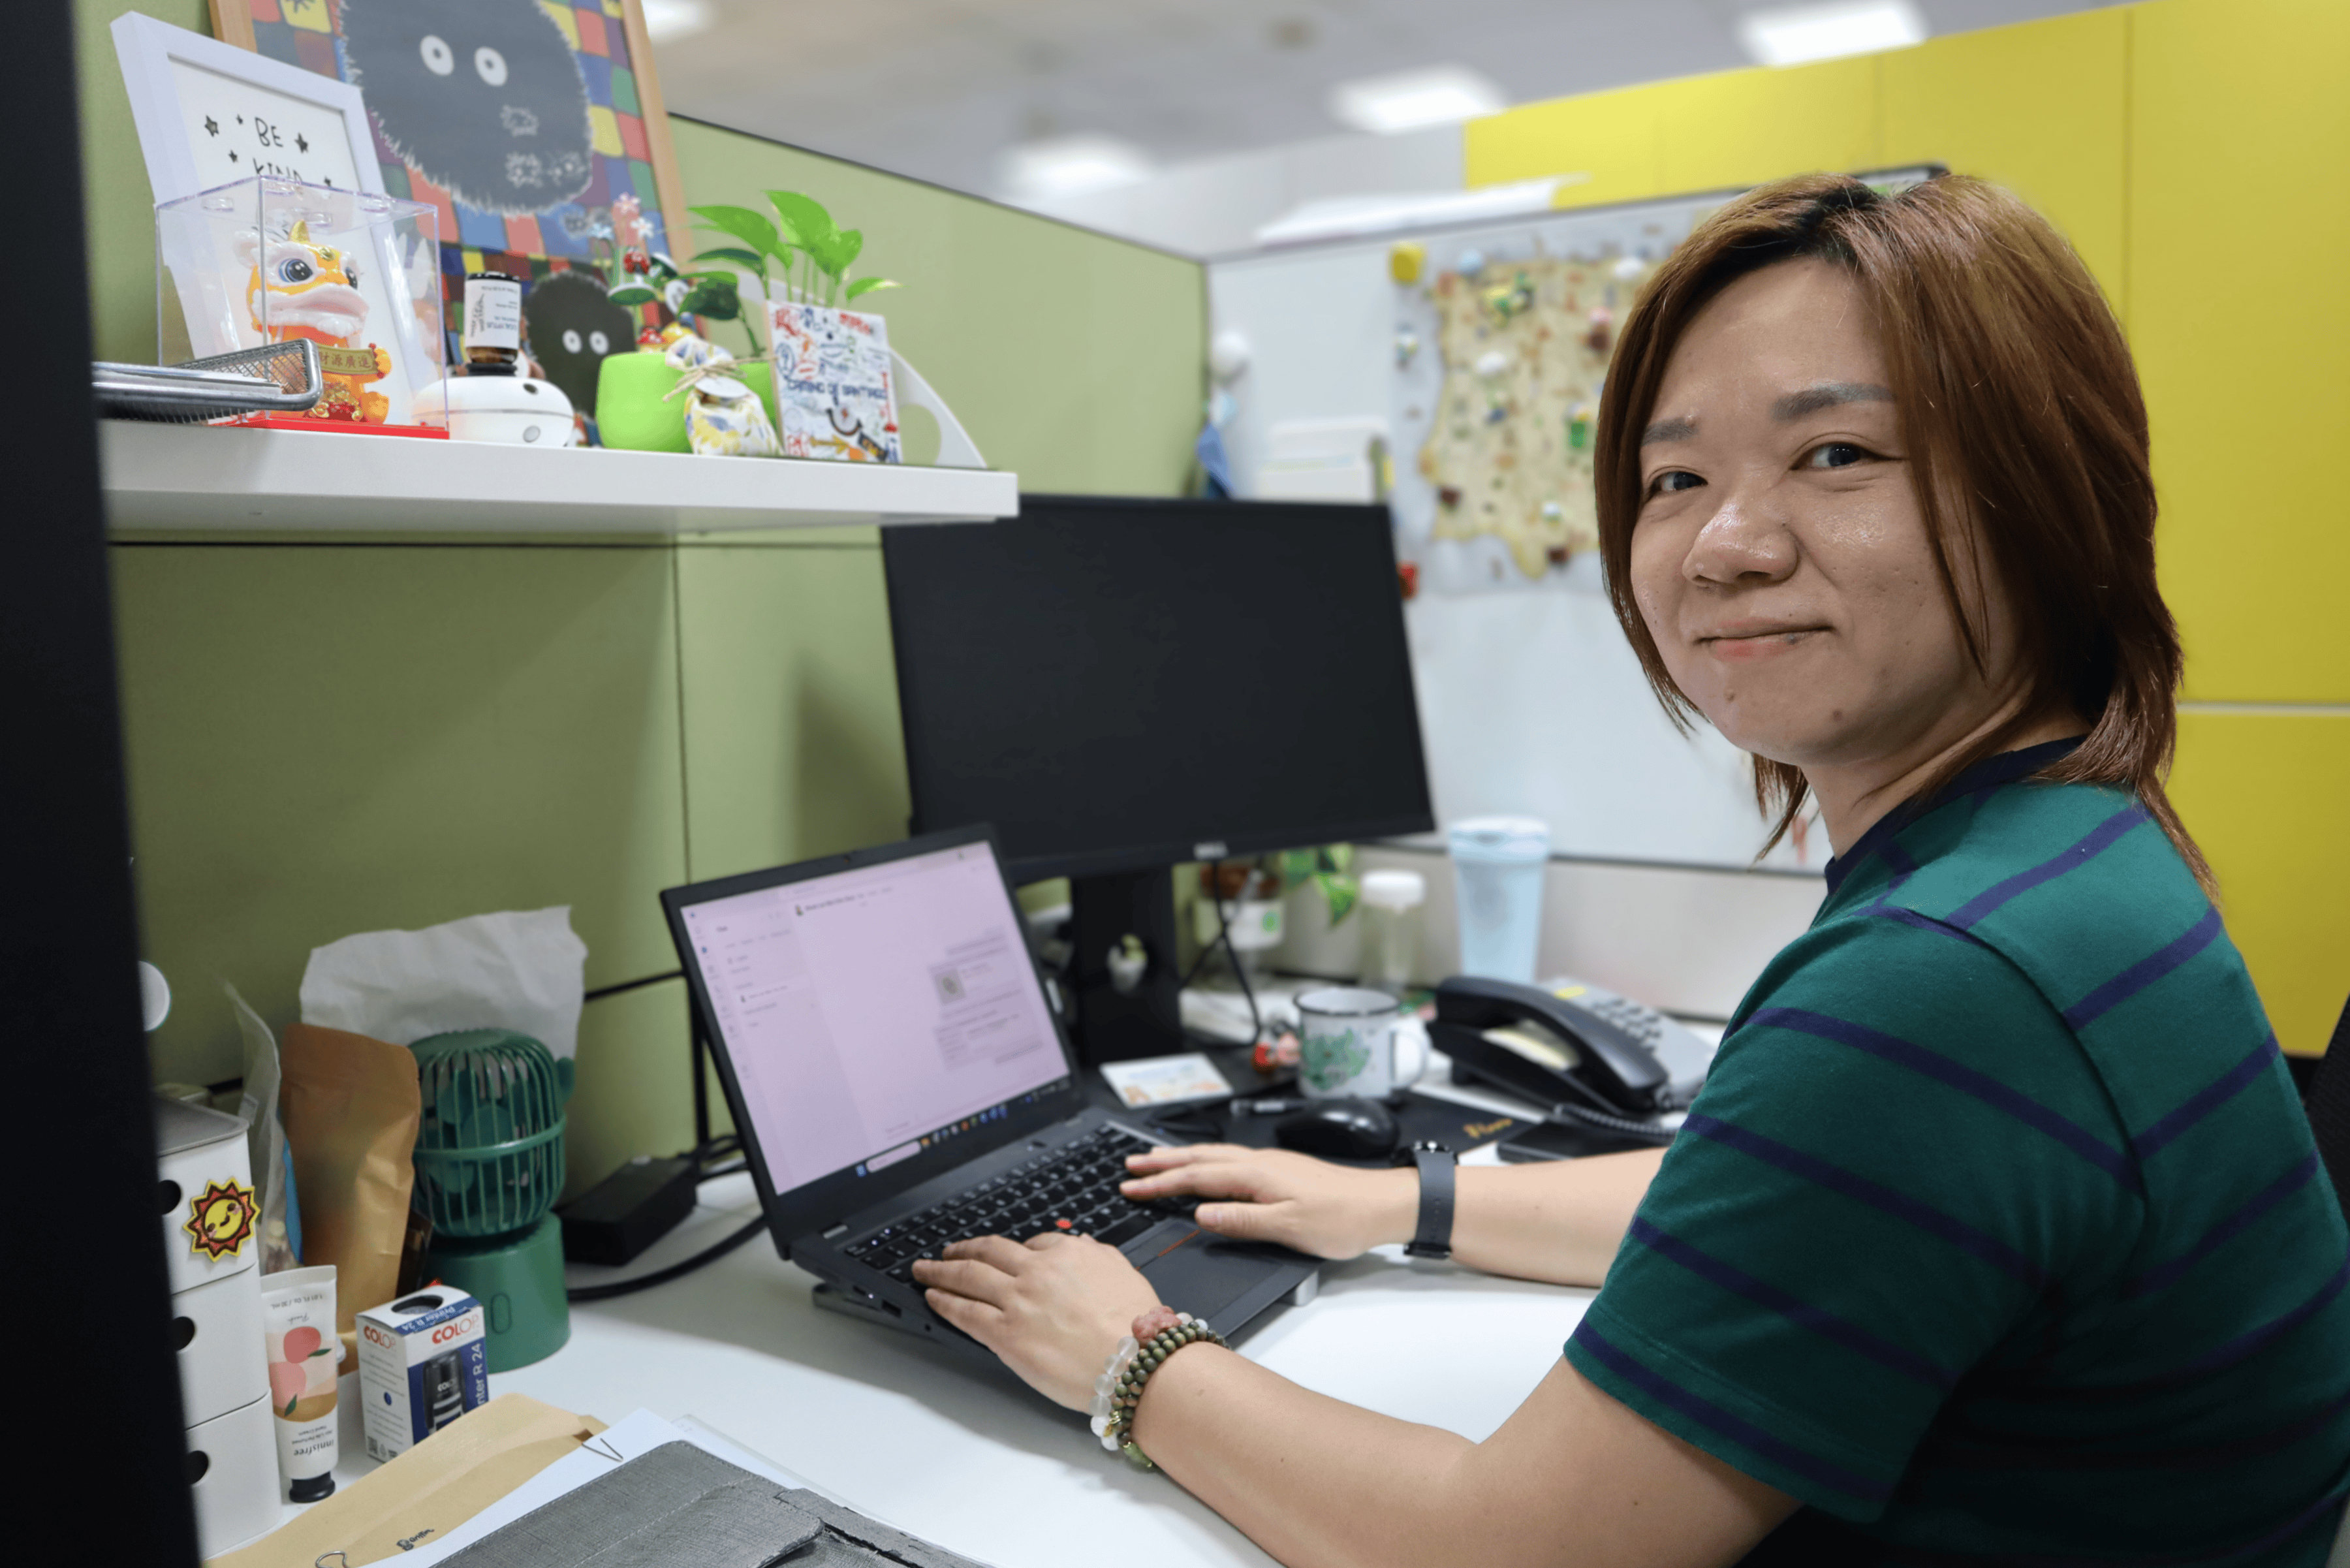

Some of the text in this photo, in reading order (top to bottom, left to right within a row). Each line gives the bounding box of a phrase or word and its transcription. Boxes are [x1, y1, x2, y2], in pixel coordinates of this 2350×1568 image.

[255, 116, 283, 148] BE
[364, 1325, 396, 1351] COLOP
[401, 1322, 415, 1332] 24
[432, 1313, 479, 1345] COLOP
[471, 1342, 486, 1405] nter R 24
[292, 1439, 334, 1456] innisfree
